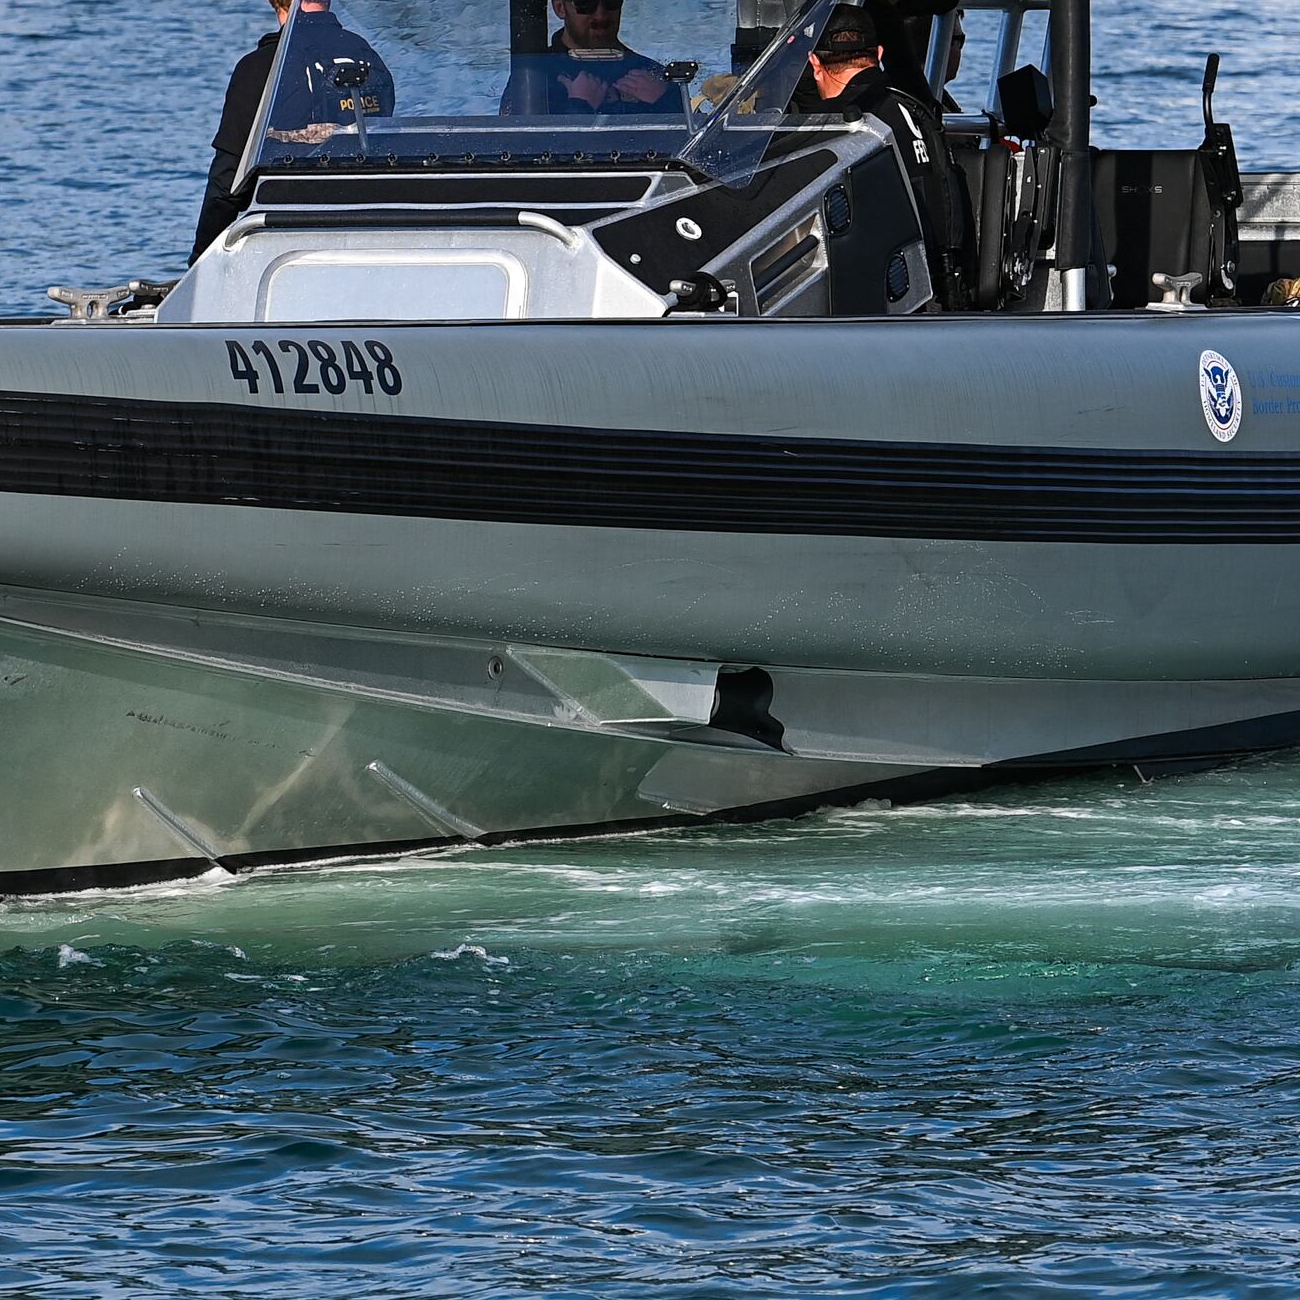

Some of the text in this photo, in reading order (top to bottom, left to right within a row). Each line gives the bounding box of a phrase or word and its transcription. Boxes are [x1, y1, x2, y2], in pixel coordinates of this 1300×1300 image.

[340, 96, 380, 111] POICE
[224, 339, 403, 396] 412848
[1251, 395, 1284, 414] Border
